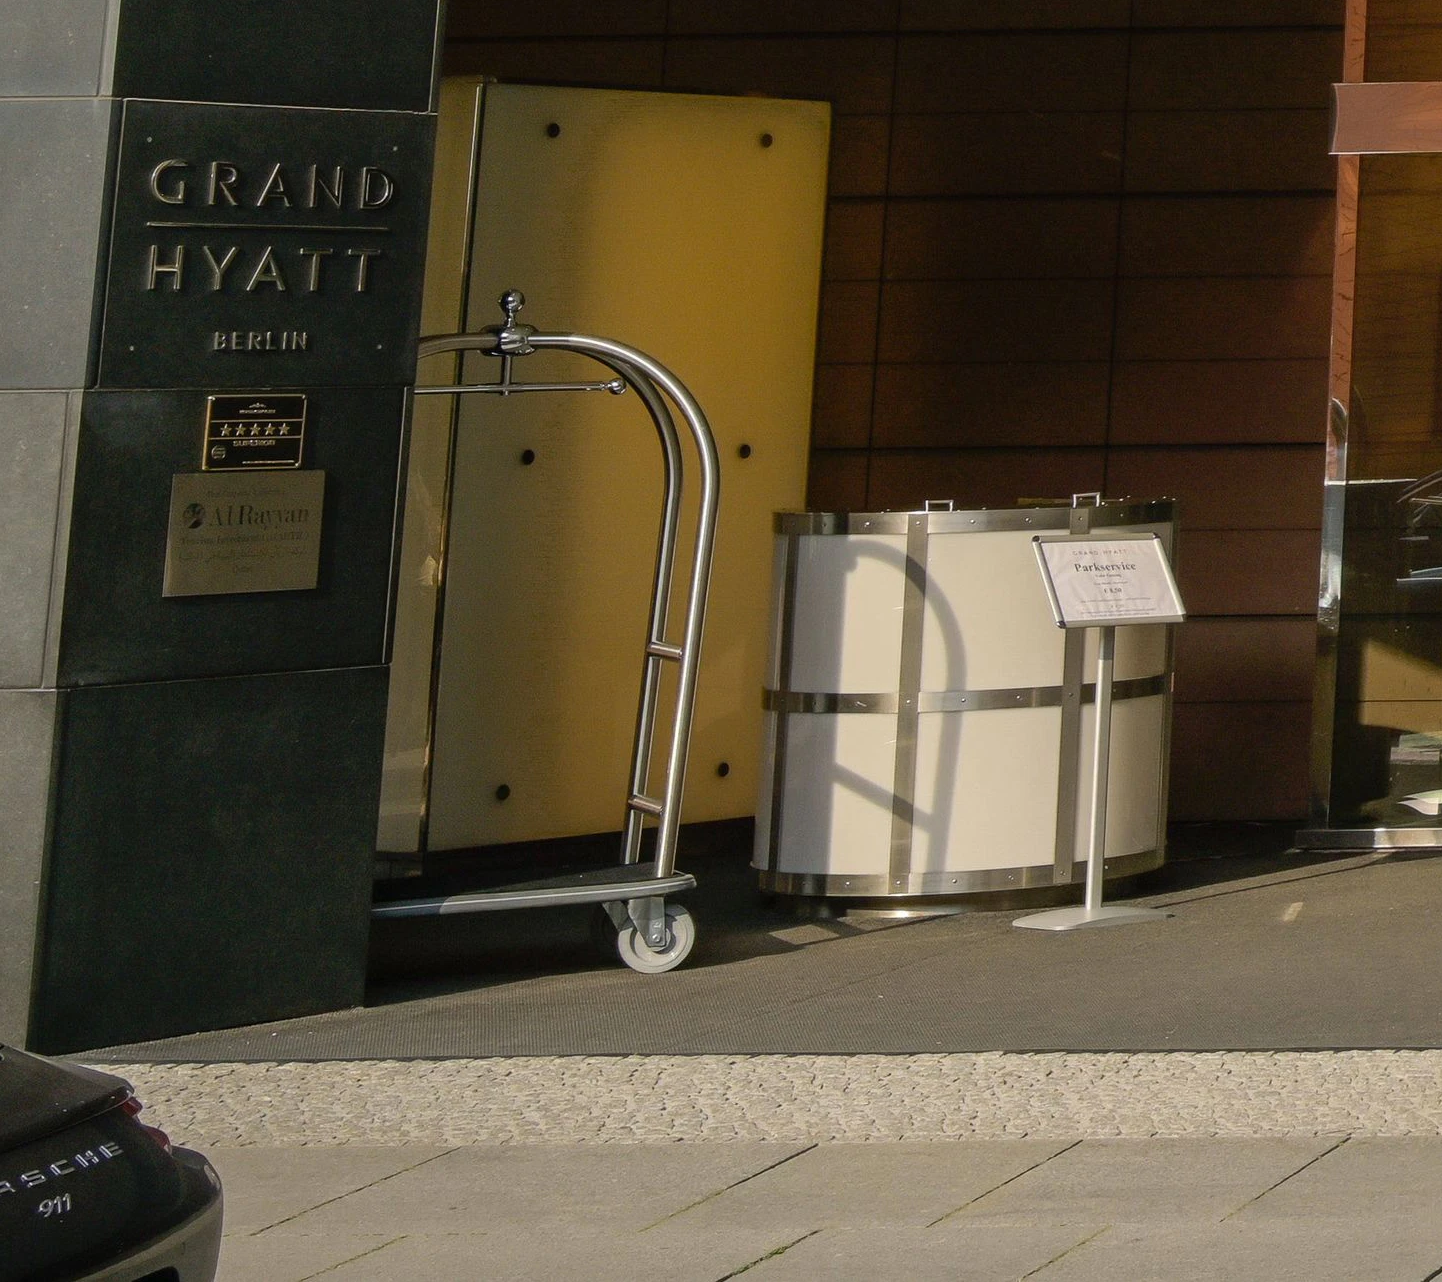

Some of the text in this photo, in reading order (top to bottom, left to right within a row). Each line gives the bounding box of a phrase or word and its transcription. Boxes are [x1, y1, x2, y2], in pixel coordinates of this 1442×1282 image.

[151, 158, 394, 210] GRAND
[148, 244, 381, 292] HYATT
[213, 331, 308, 351] BERLIN
[1074, 561, 1137, 573] Parkservice
[38, 1192, 72, 1218] 911
